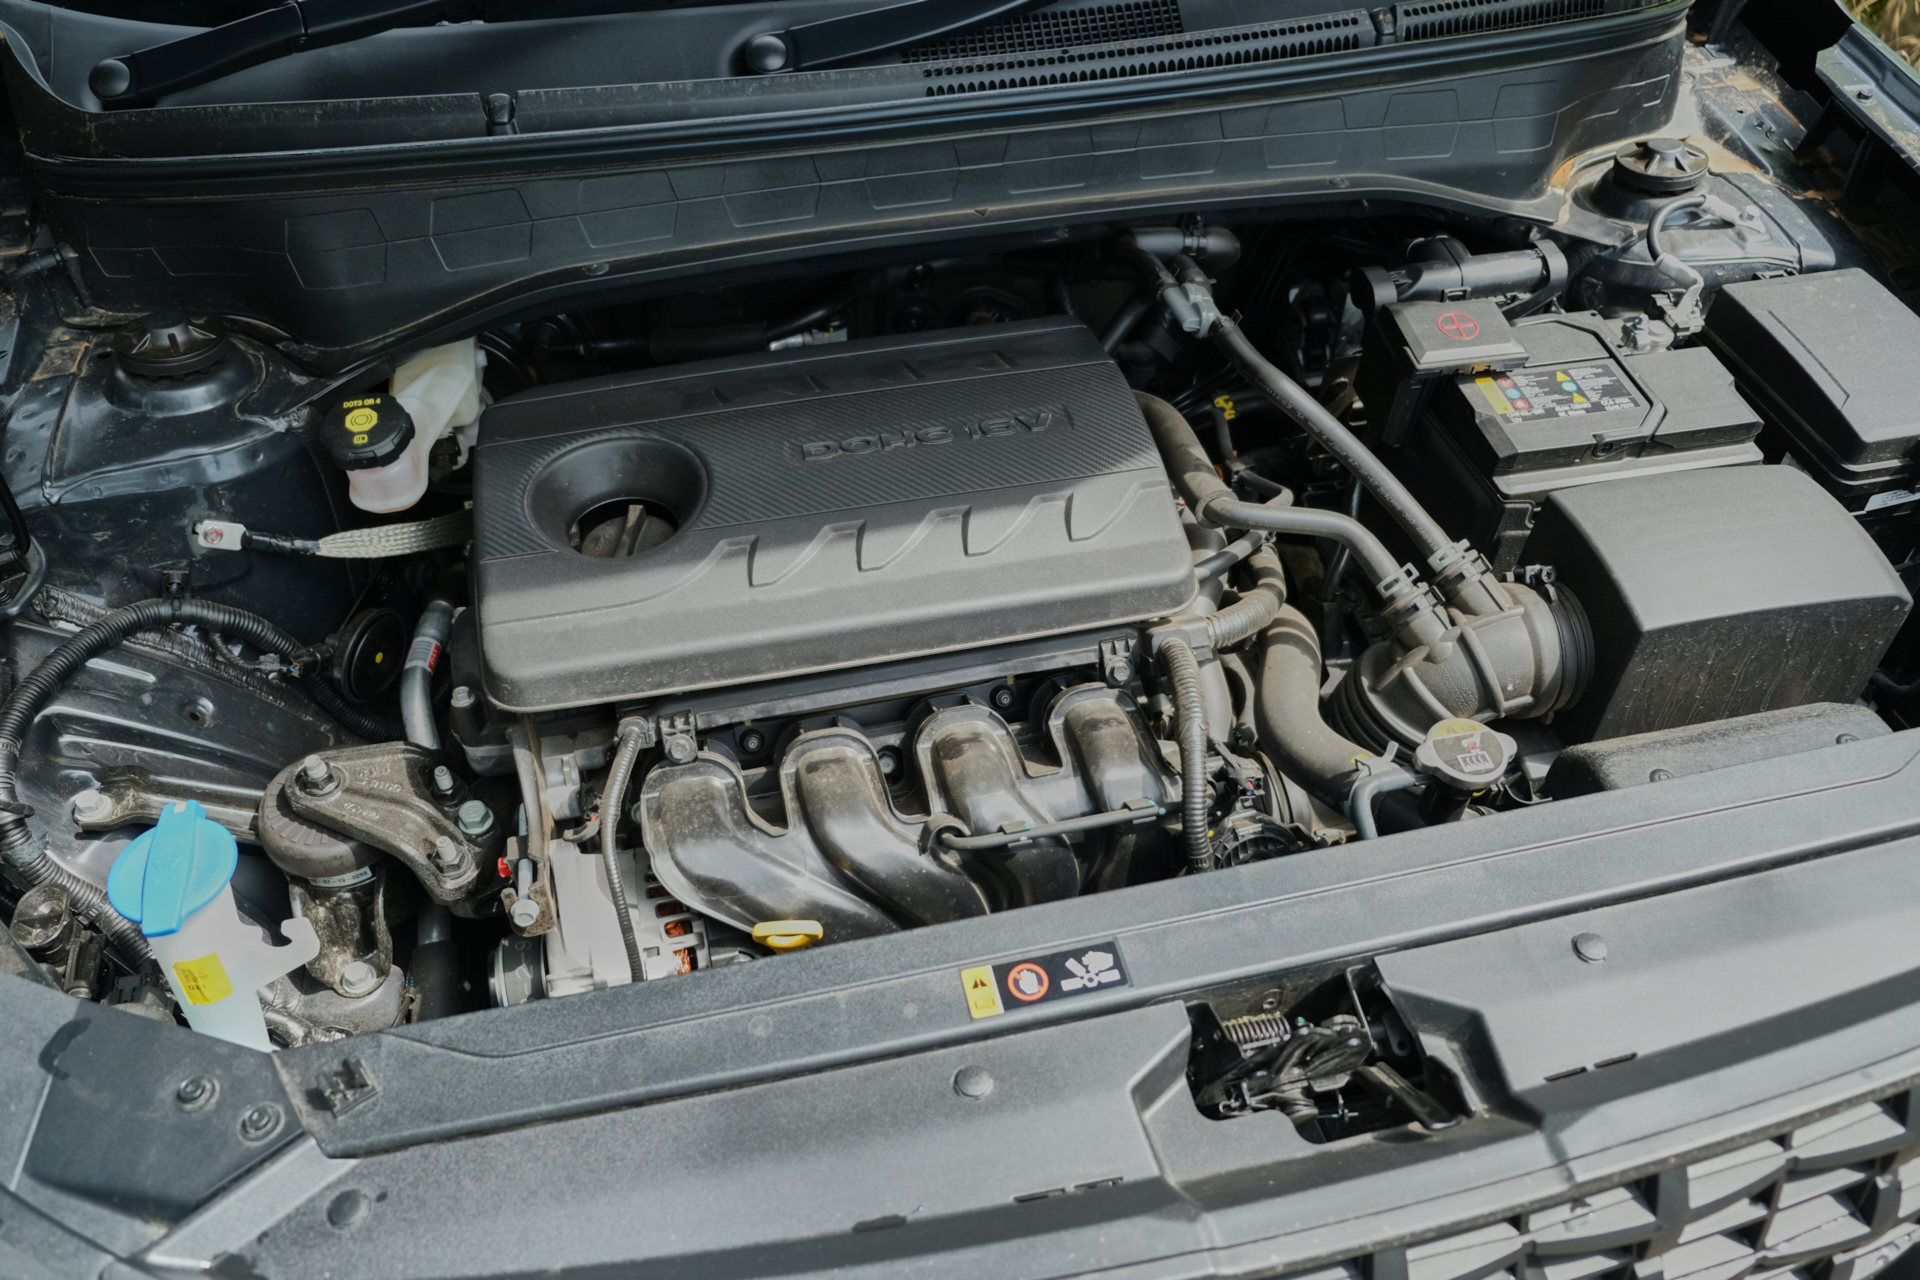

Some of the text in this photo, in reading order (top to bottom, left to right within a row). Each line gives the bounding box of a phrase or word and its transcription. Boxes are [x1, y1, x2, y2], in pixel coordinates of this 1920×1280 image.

[364, 398, 375, 406] OR
[801, 412, 1052, 461] DOHC 16V
